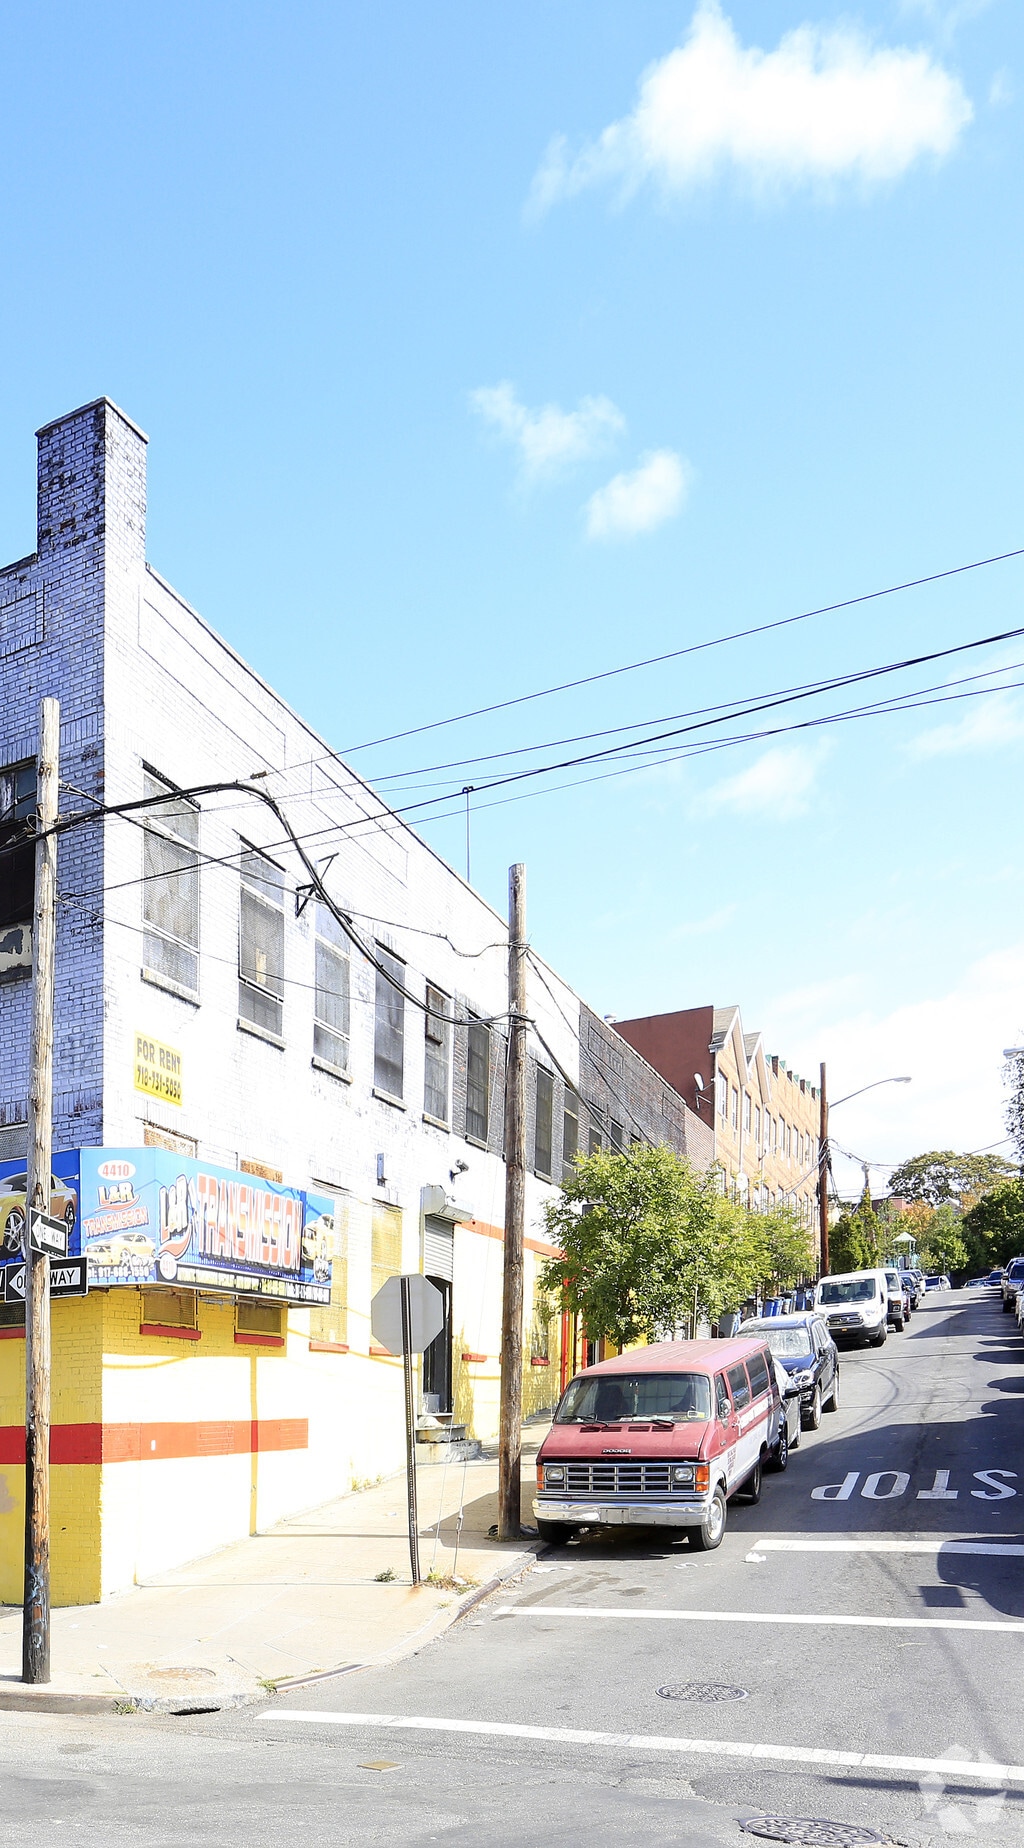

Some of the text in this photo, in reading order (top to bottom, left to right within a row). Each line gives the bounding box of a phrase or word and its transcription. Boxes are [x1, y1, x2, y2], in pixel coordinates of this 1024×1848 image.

[137, 1037, 181, 1075] FOR RENT
[137, 1065, 182, 1100] 718-731-5050
[102, 1164, 130, 1176] 4410
[98, 1182, 134, 1206] L&R
[36, 1223, 63, 1249] ONE WAY
[83, 1206, 150, 1239] TRANSMISSION
[159, 1172, 304, 1274] L&R TRANSMISSION
[50, 1269, 75, 1286] WAY
[810, 1469, 1019, 1501] STOP
